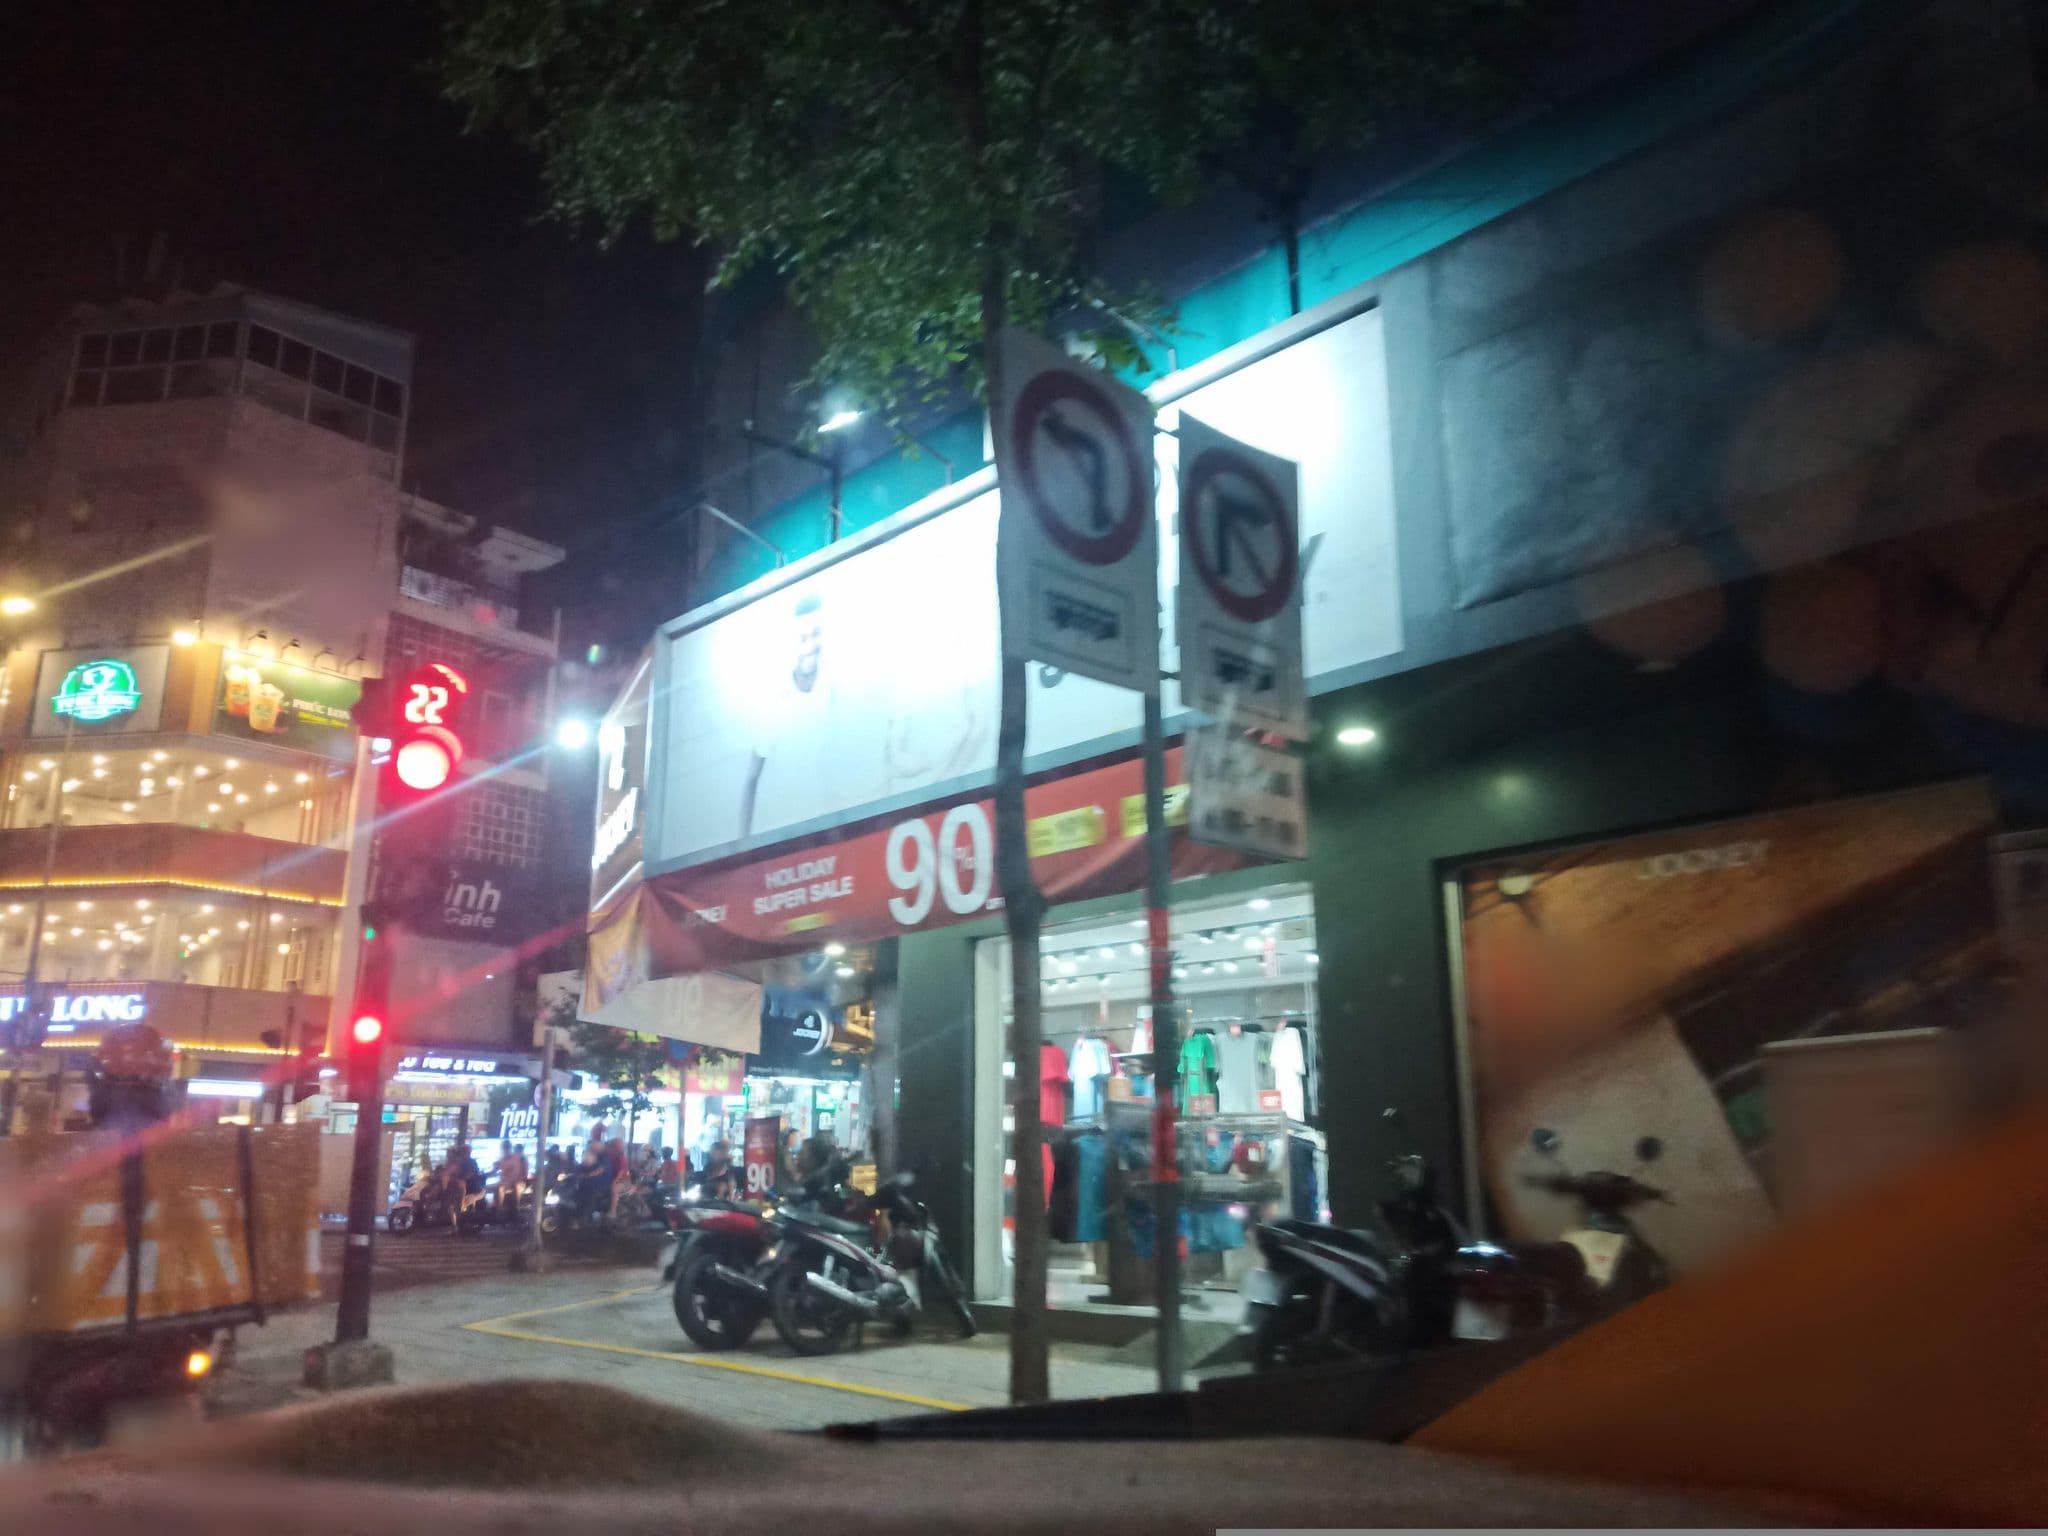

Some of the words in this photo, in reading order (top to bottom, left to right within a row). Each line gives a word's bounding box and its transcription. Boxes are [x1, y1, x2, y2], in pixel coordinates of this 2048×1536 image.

[405, 684, 448, 724] 22
[765, 856, 837, 889] HOLIDAY
[886, 803, 993, 926] 90
[753, 888, 808, 915] SUPER
[810, 875, 855, 903] SALE
[443, 907, 497, 928] Cafe
[50, 995, 145, 1022] LONG
[508, 1127, 537, 1138] Cafe
[747, 1162, 775, 1193] 90
